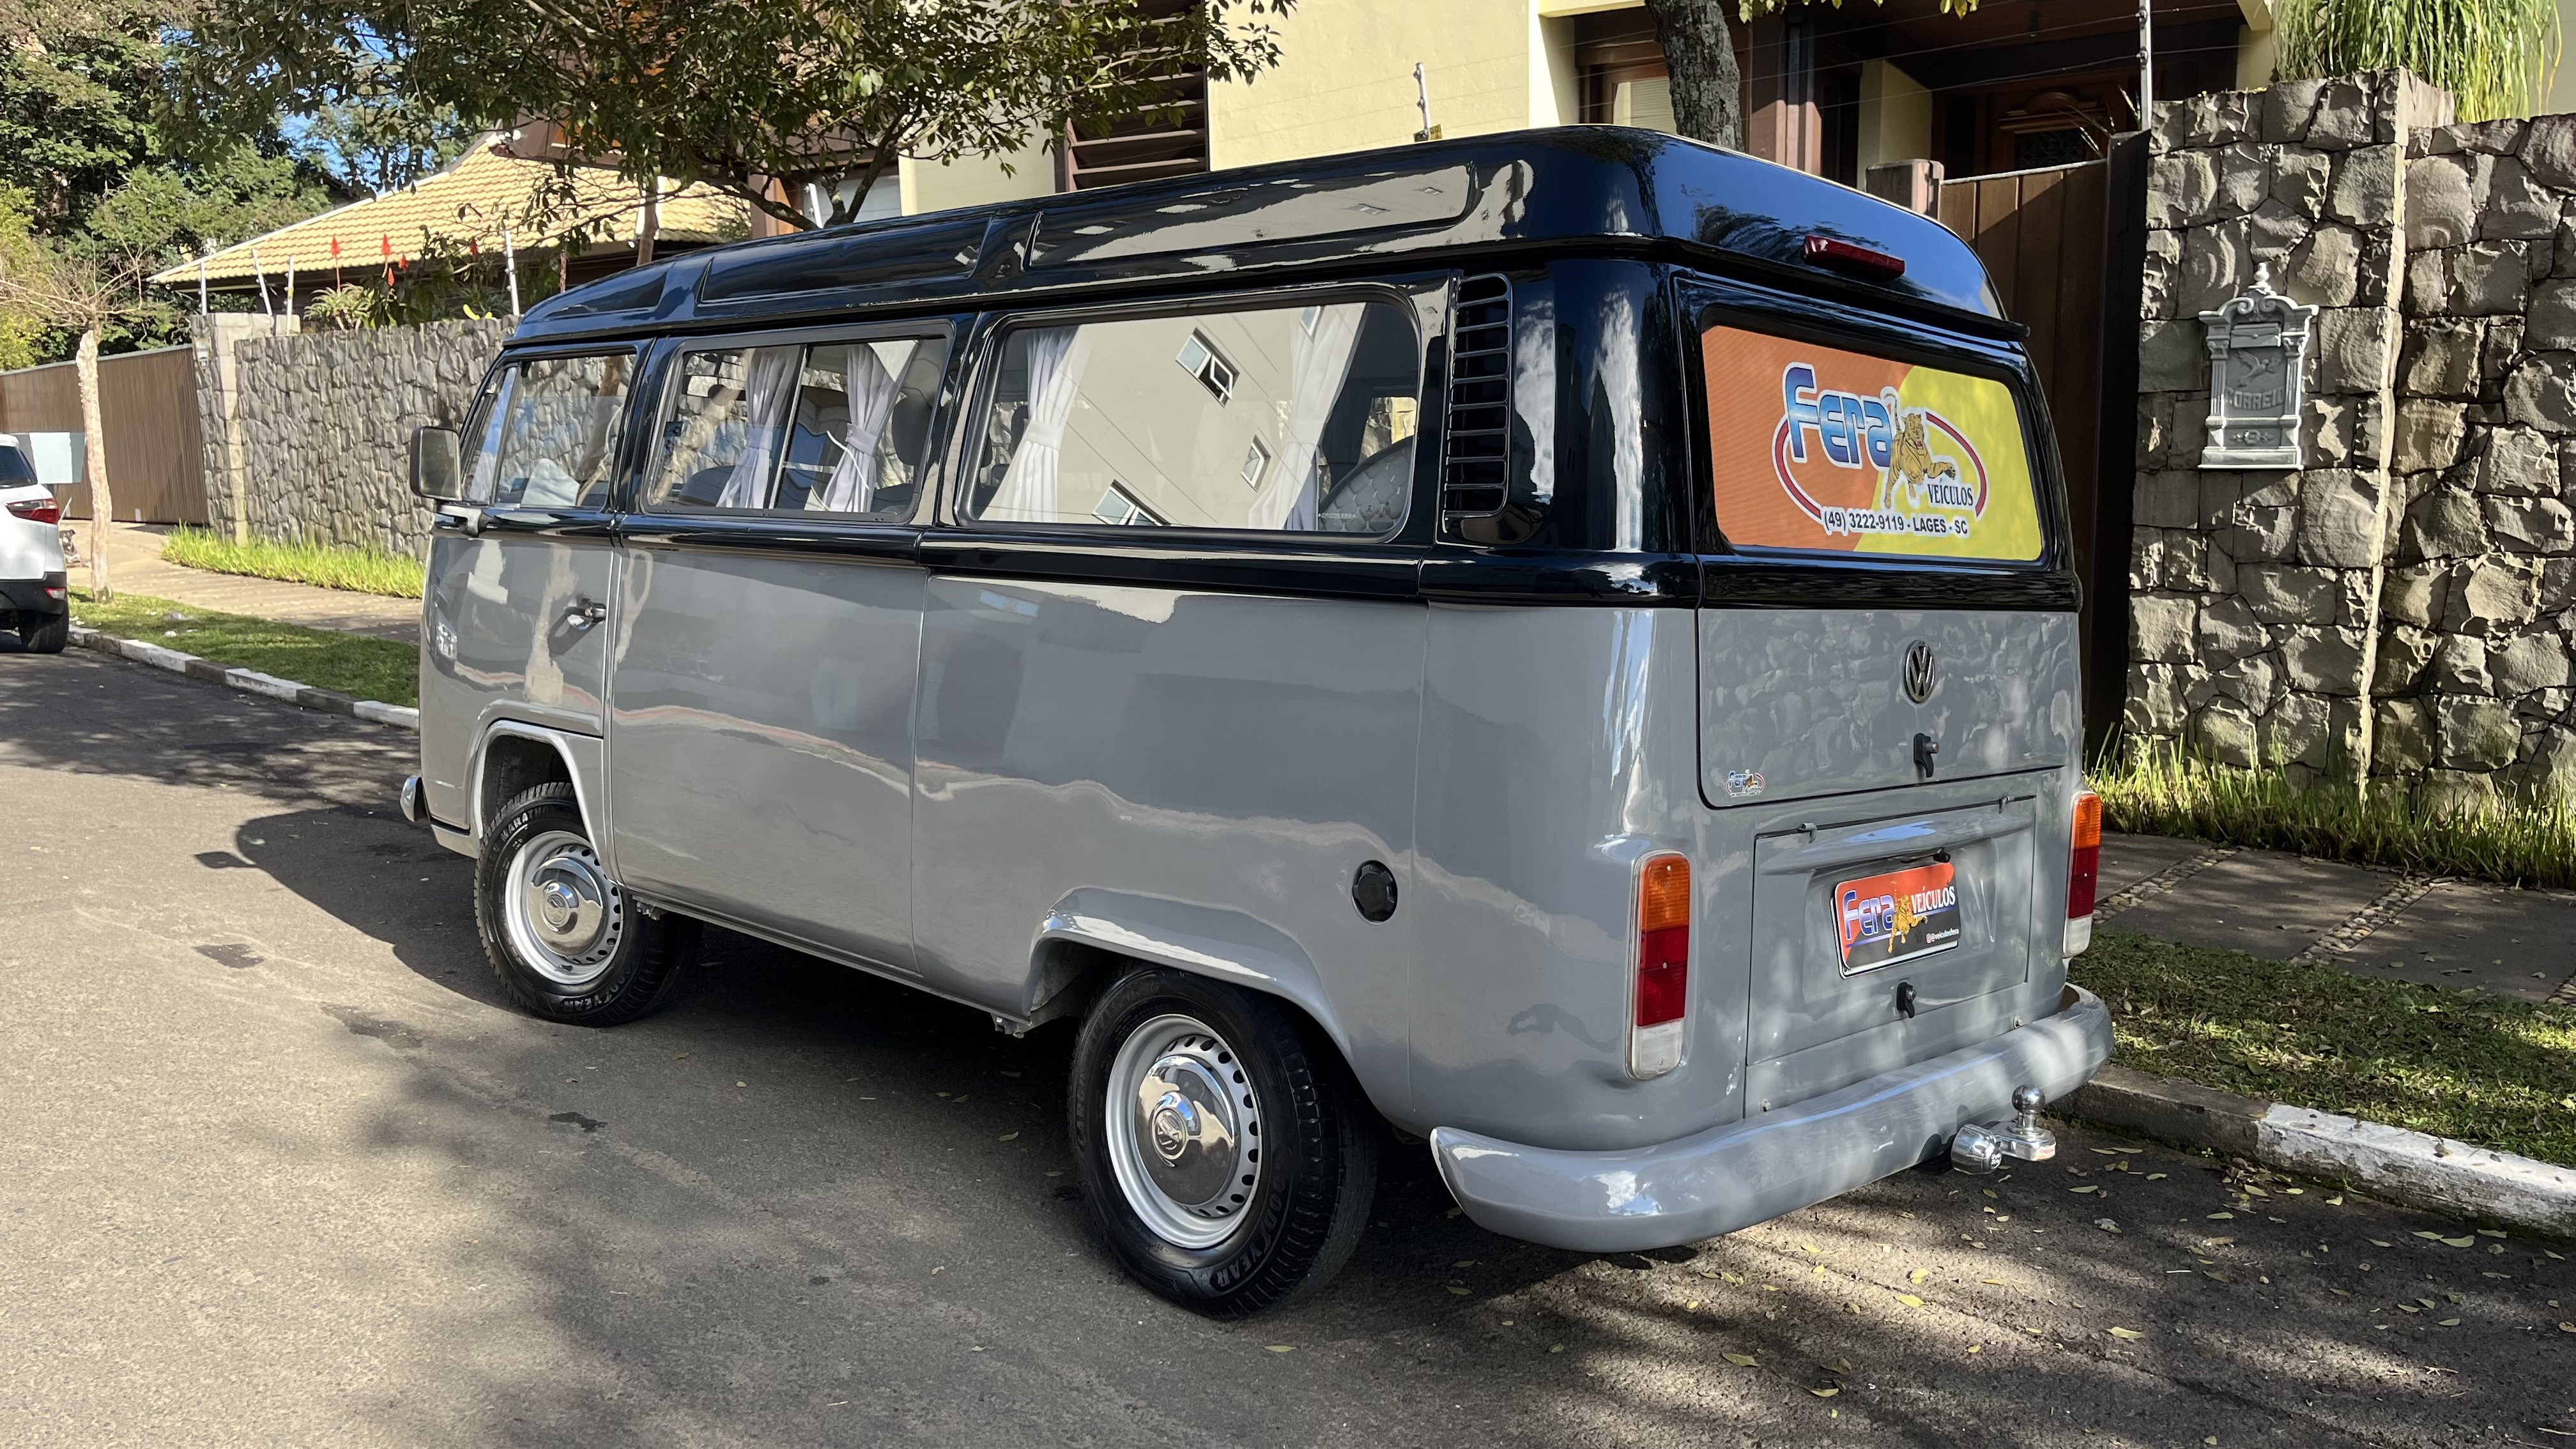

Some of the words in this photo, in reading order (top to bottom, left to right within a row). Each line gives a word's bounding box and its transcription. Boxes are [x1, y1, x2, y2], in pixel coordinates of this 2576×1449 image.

[2225, 386, 2284, 410] CORREIO
[1927, 478, 1974, 507] VEÍCULOS
[1824, 511, 1846, 532] (49)
[1848, 513, 1905, 531] 3222-9119
[1912, 517, 1947, 533] LAGES
[1954, 519, 1968, 535] SC
[1907, 641, 1934, 700] VW
[1910, 885, 1956, 914] VEÍCULOS
